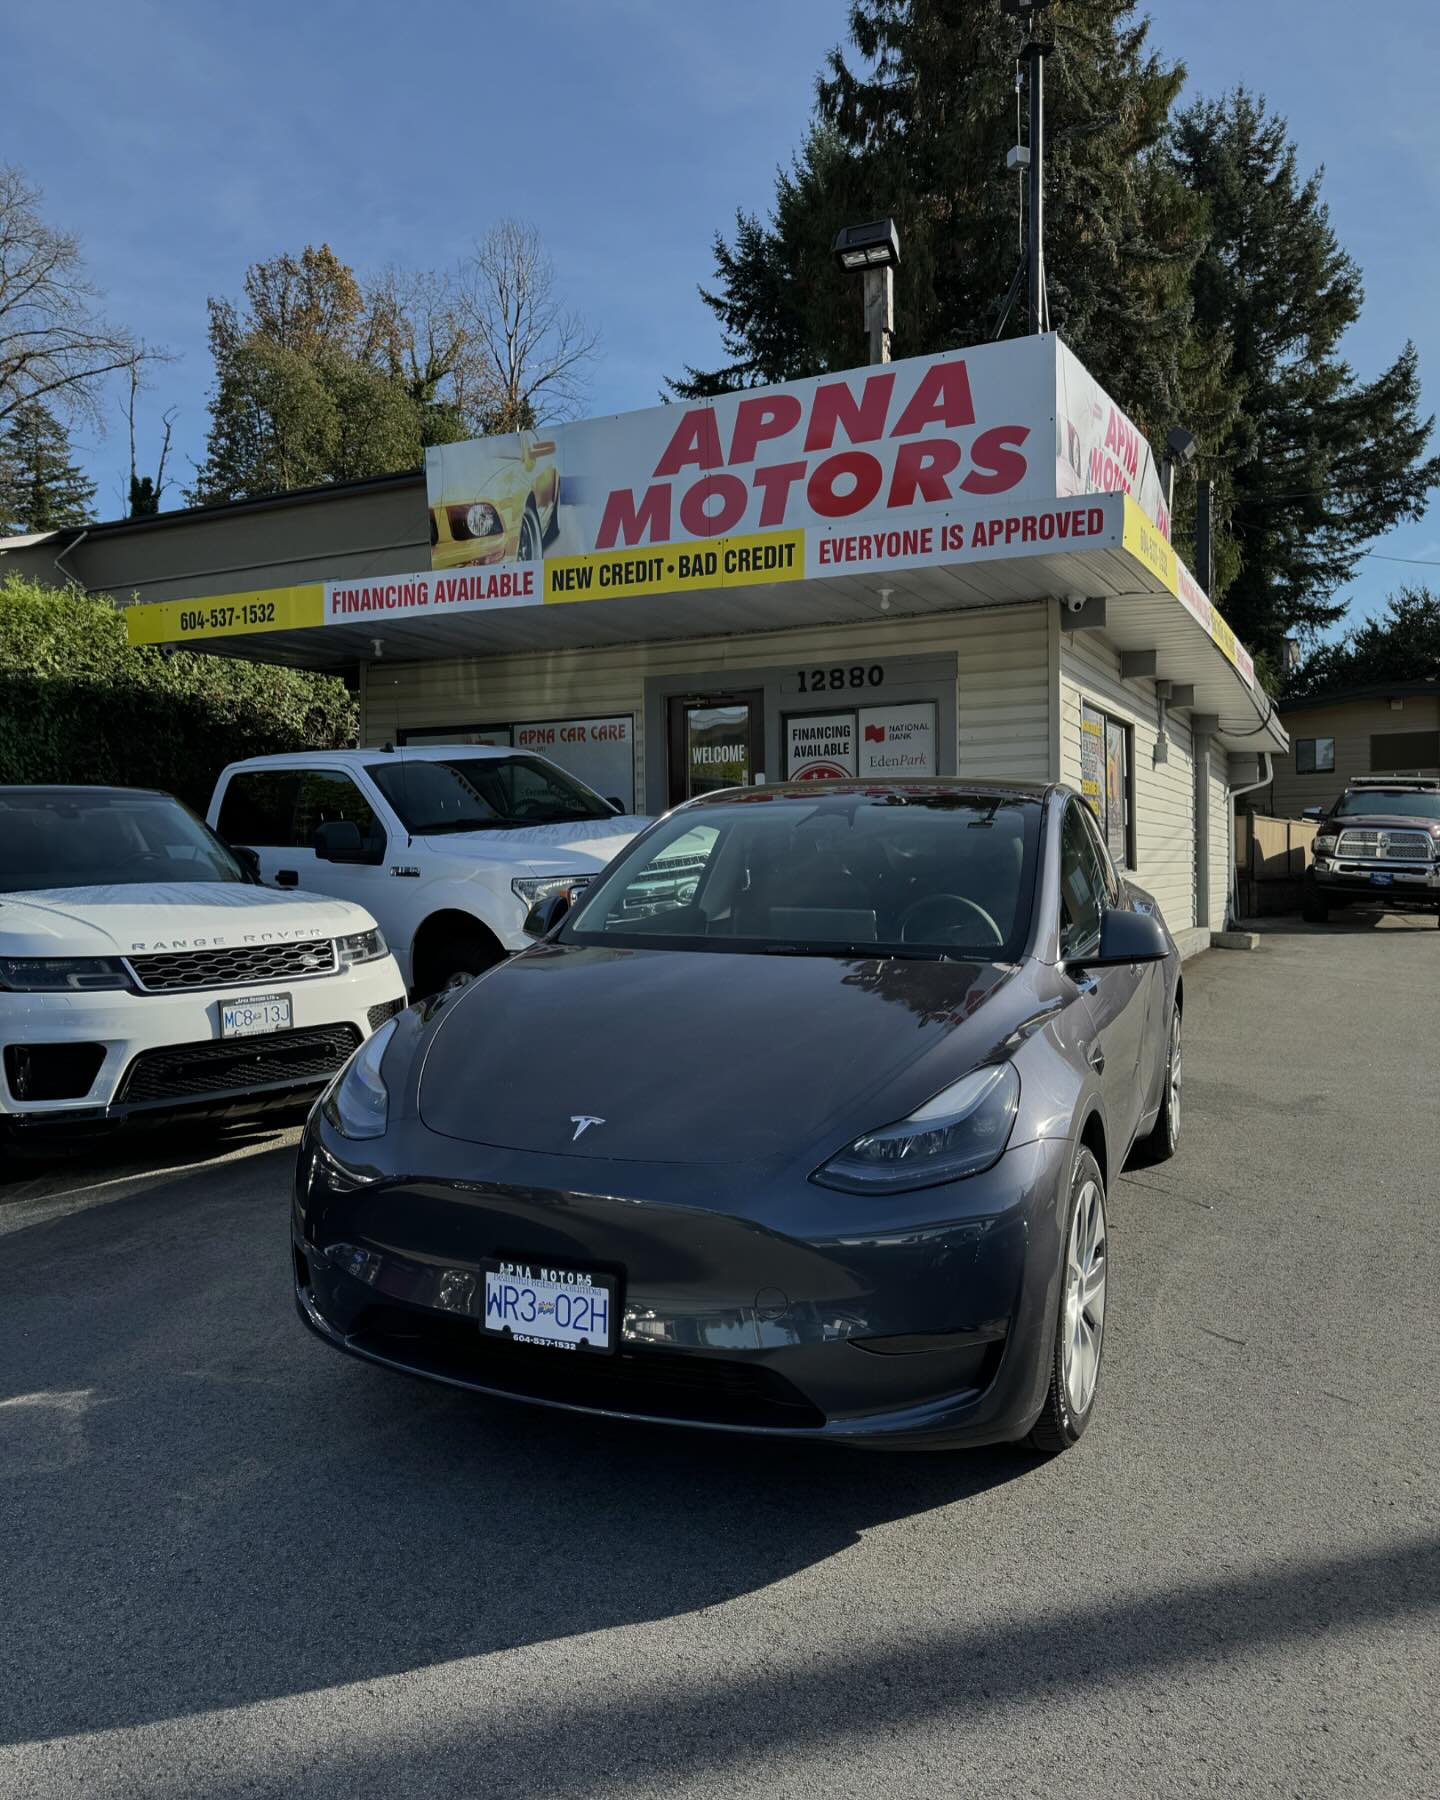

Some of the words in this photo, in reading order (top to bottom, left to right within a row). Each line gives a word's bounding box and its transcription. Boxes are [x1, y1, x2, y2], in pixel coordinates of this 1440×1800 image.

[652, 360, 976, 477] APNA
[1105, 406, 1139, 480] APNA
[594, 425, 1031, 550] MOTORS
[819, 528, 933, 564] EVERYONE
[941, 524, 964, 551] IS
[971, 508, 1104, 548] APPROVED
[552, 566, 593, 592] NEW
[600, 558, 664, 587] CREDIT
[679, 552, 717, 578] BAD
[725, 543, 795, 573] CREDIT
[332, 582, 428, 614] FINANCING
[434, 571, 534, 605] AVAILABLE
[180, 603, 275, 631] 604-537-1532
[798, 665, 884, 693] 12880
[519, 728, 555, 745] APNA
[560, 726, 587, 743] CAR
[591, 724, 626, 742] CARE
[792, 725, 851, 741] FINANCING
[889, 723, 930, 732] NATIONAL
[889, 732, 912, 741] BANK
[692, 744, 745, 765] WELCOME
[793, 742, 850, 759] AVAILABLE
[869, 752, 927, 768] EdenPark
[131, 937, 225, 951] RANGE
[243, 928, 322, 943] ROVER
[224, 1010, 253, 1029] MC8
[264, 1004, 289, 1024] 13J
[500, 1262, 532, 1280] APNA
[540, 1268, 592, 1287] MOTORS
[487, 1283, 537, 1322] WR3
[555, 1294, 607, 1334] 02H
[513, 1334, 577, 1350] 604-537-1532
